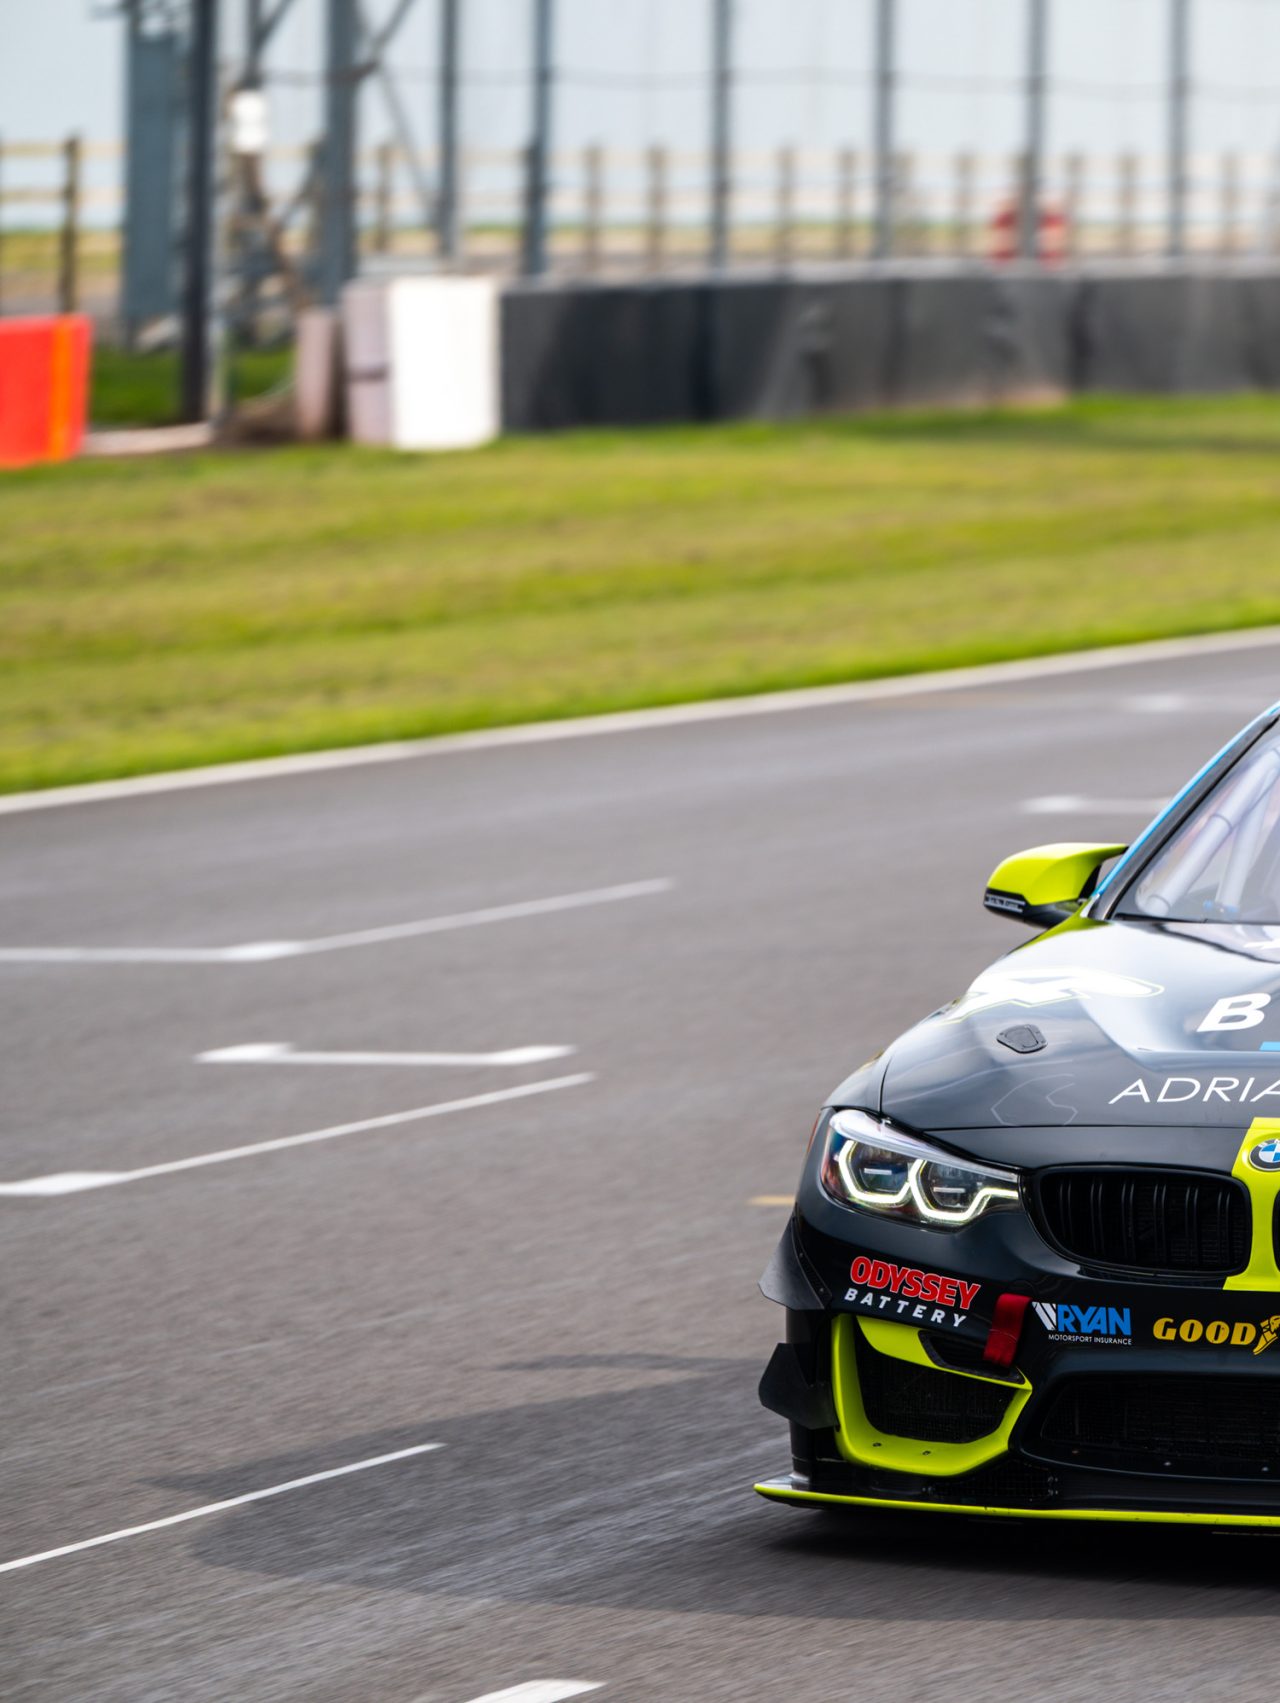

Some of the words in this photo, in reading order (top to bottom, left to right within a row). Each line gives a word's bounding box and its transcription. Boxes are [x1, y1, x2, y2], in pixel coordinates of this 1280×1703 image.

[849, 1256, 981, 1311] ODYSSEY
[844, 1287, 968, 1328] BATTERY
[1057, 1304, 1132, 1335] RYAN
[1048, 1333, 1092, 1343] MOTORSPORT
[1093, 1336, 1132, 1345] INSURANCE
